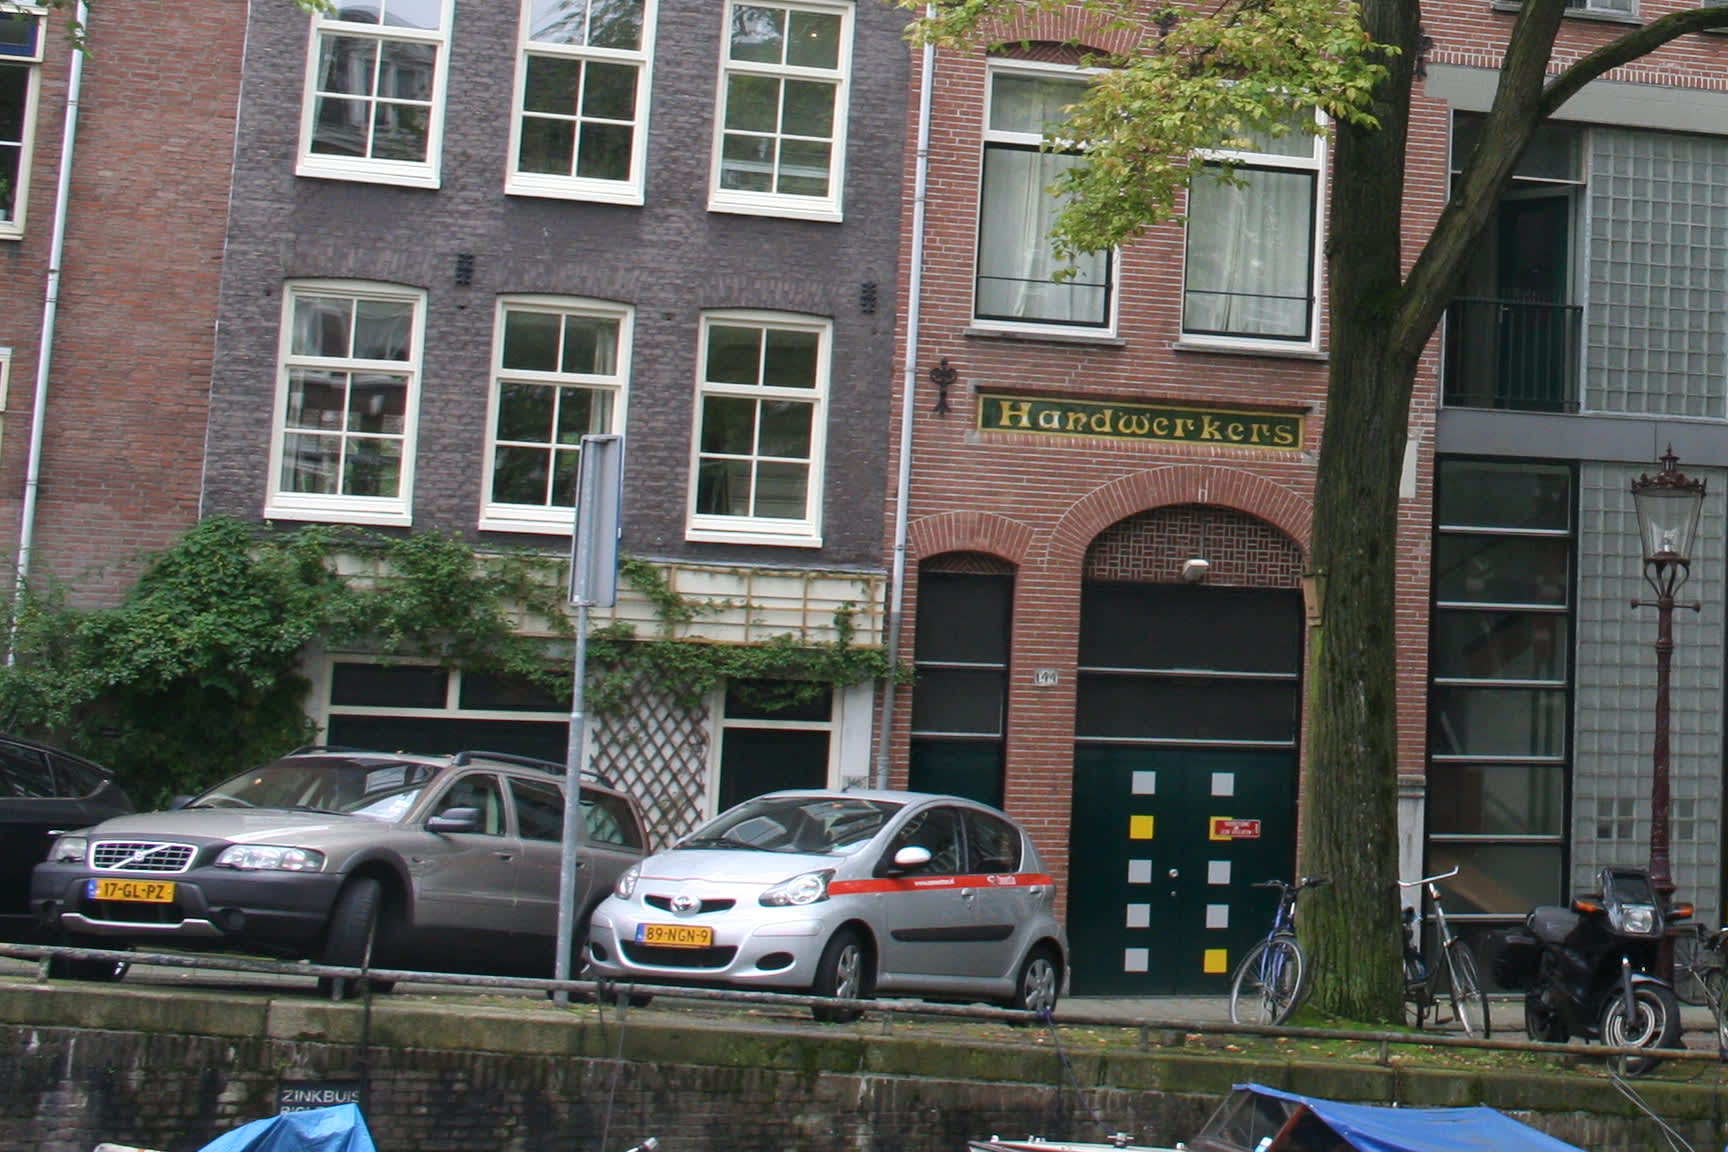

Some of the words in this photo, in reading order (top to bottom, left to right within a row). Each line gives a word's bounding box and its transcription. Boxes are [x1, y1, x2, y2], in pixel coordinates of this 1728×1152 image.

[999, 400, 1294, 445] Handwerkers
[104, 882, 165, 899] 17-GL-PZ
[647, 927, 709, 942] 89-NGN-9
[281, 1089, 360, 1103] ZINKBUIS
